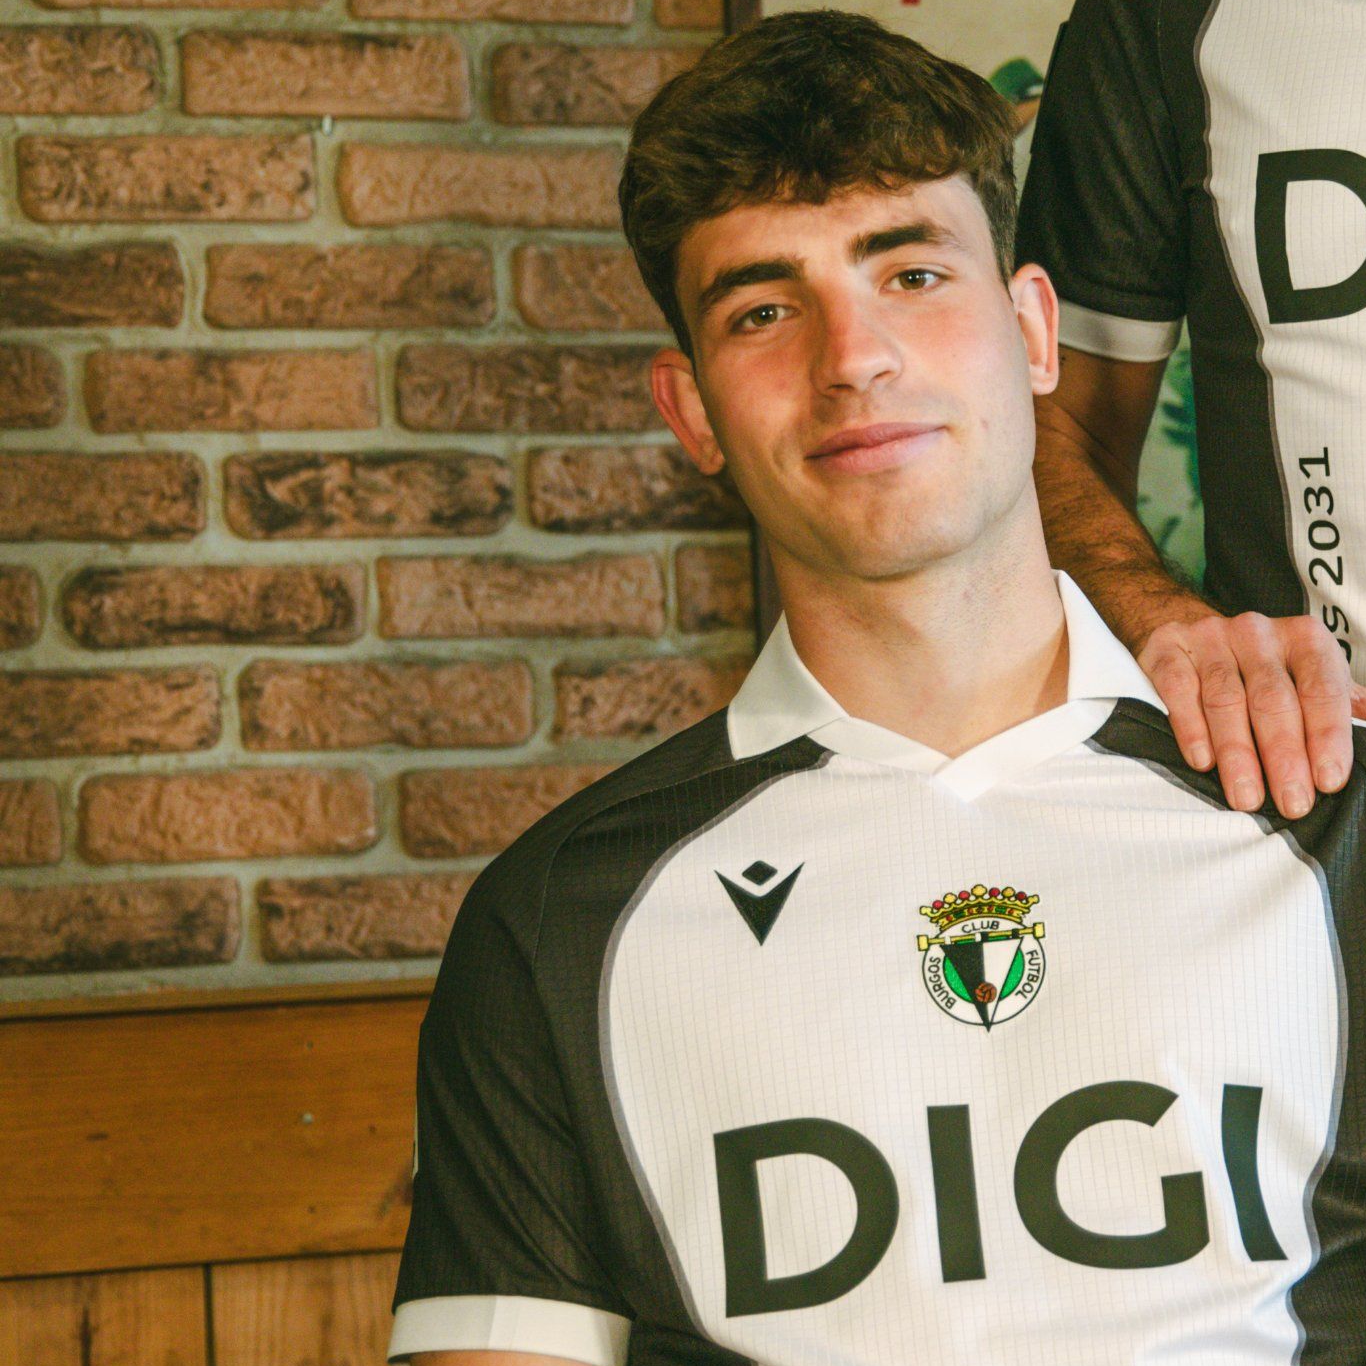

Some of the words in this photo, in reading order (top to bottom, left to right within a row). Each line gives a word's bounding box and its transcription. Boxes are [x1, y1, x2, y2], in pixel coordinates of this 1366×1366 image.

[1298, 446, 1344, 587] 2031
[961, 920, 1000, 934] CLUB
[927, 956, 957, 1010] BURGOS
[1014, 949, 1042, 1000] FUTBOL
[713, 1080, 1288, 1318] DIGI
